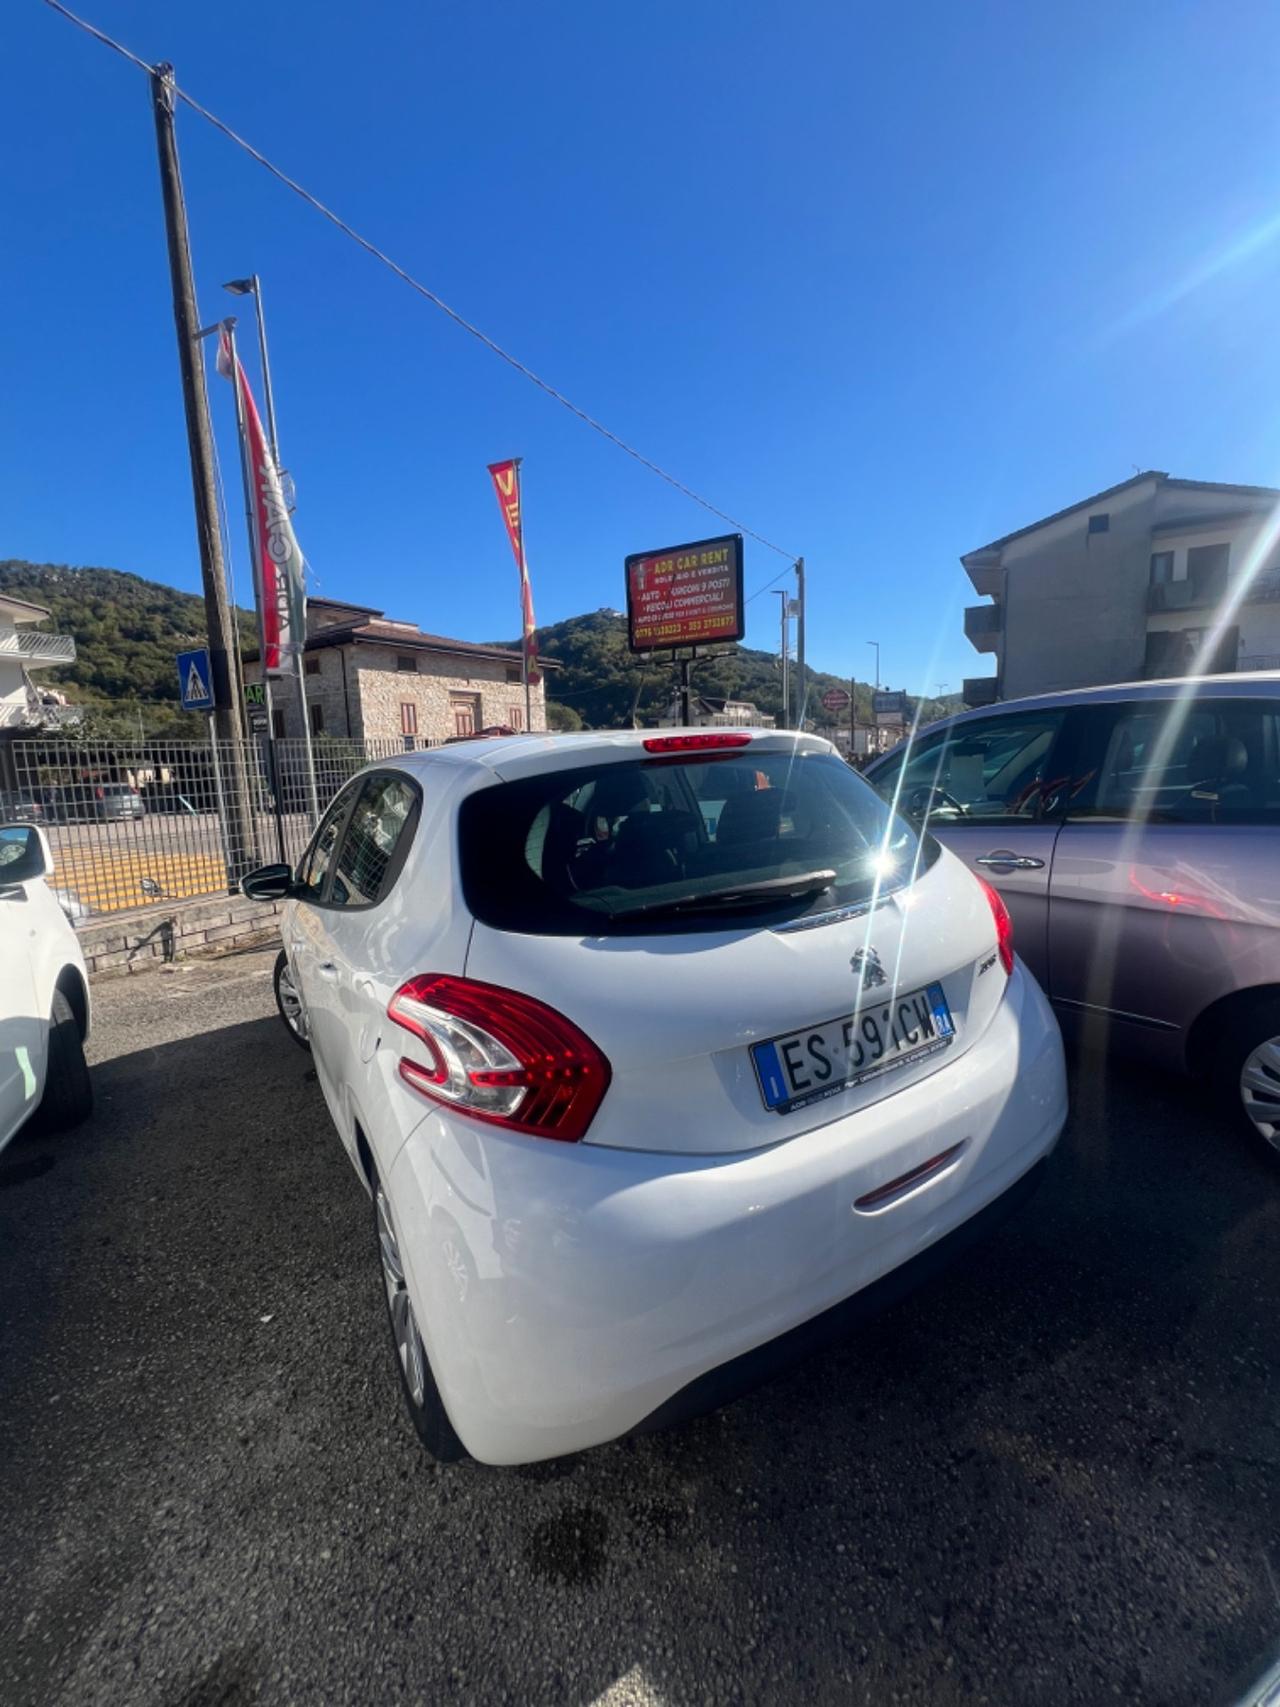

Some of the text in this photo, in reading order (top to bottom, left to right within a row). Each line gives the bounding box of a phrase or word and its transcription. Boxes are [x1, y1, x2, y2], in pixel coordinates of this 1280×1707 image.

[655, 548, 729, 574] ADR CAR RENT
[698, 565, 729, 577] VENDITA
[641, 591, 660, 601] AUTO
[669, 583, 700, 597] URGONI
[708, 578, 731, 590] POSTI
[673, 592, 724, 607] COMMERCIALI
[781, 1034, 832, 1092] ES
[842, 993, 936, 1068] 591CW
